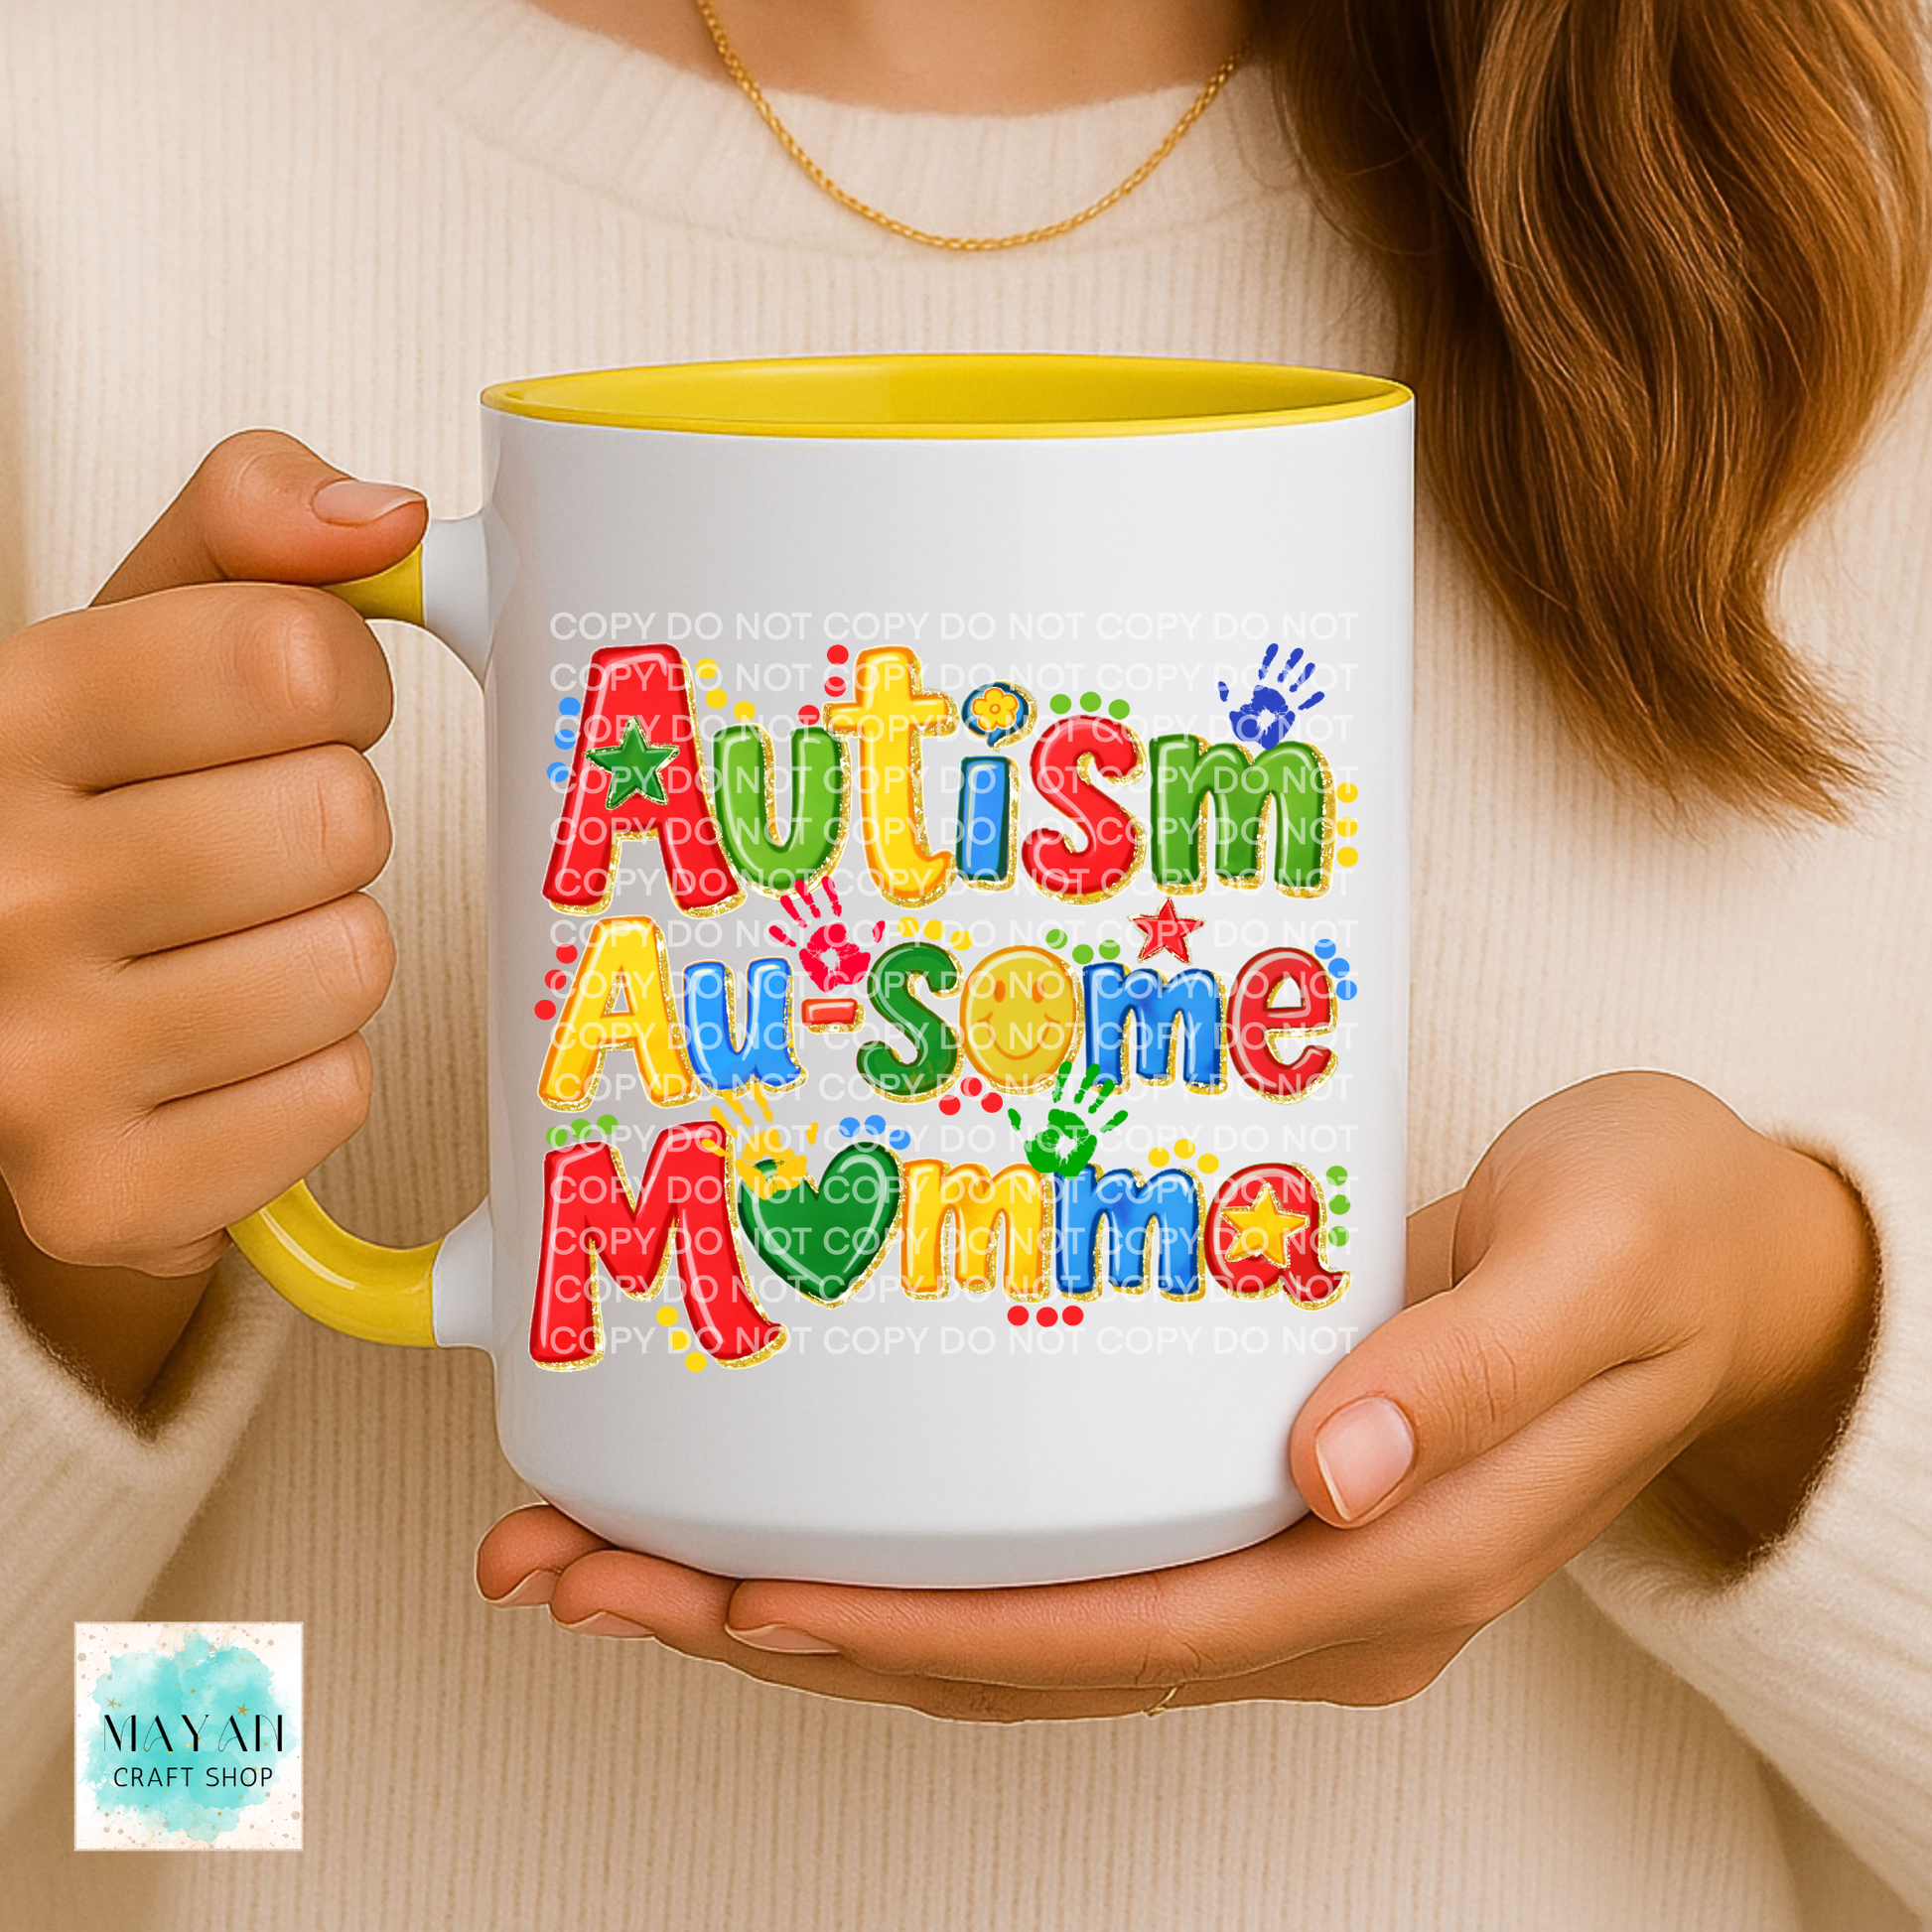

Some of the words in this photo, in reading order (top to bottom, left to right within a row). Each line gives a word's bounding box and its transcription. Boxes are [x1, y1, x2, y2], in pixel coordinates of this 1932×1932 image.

[542, 643, 1337, 915] Autism
[537, 915, 1337, 1110] Au-some
[528, 1121, 1350, 1372] Mmma
